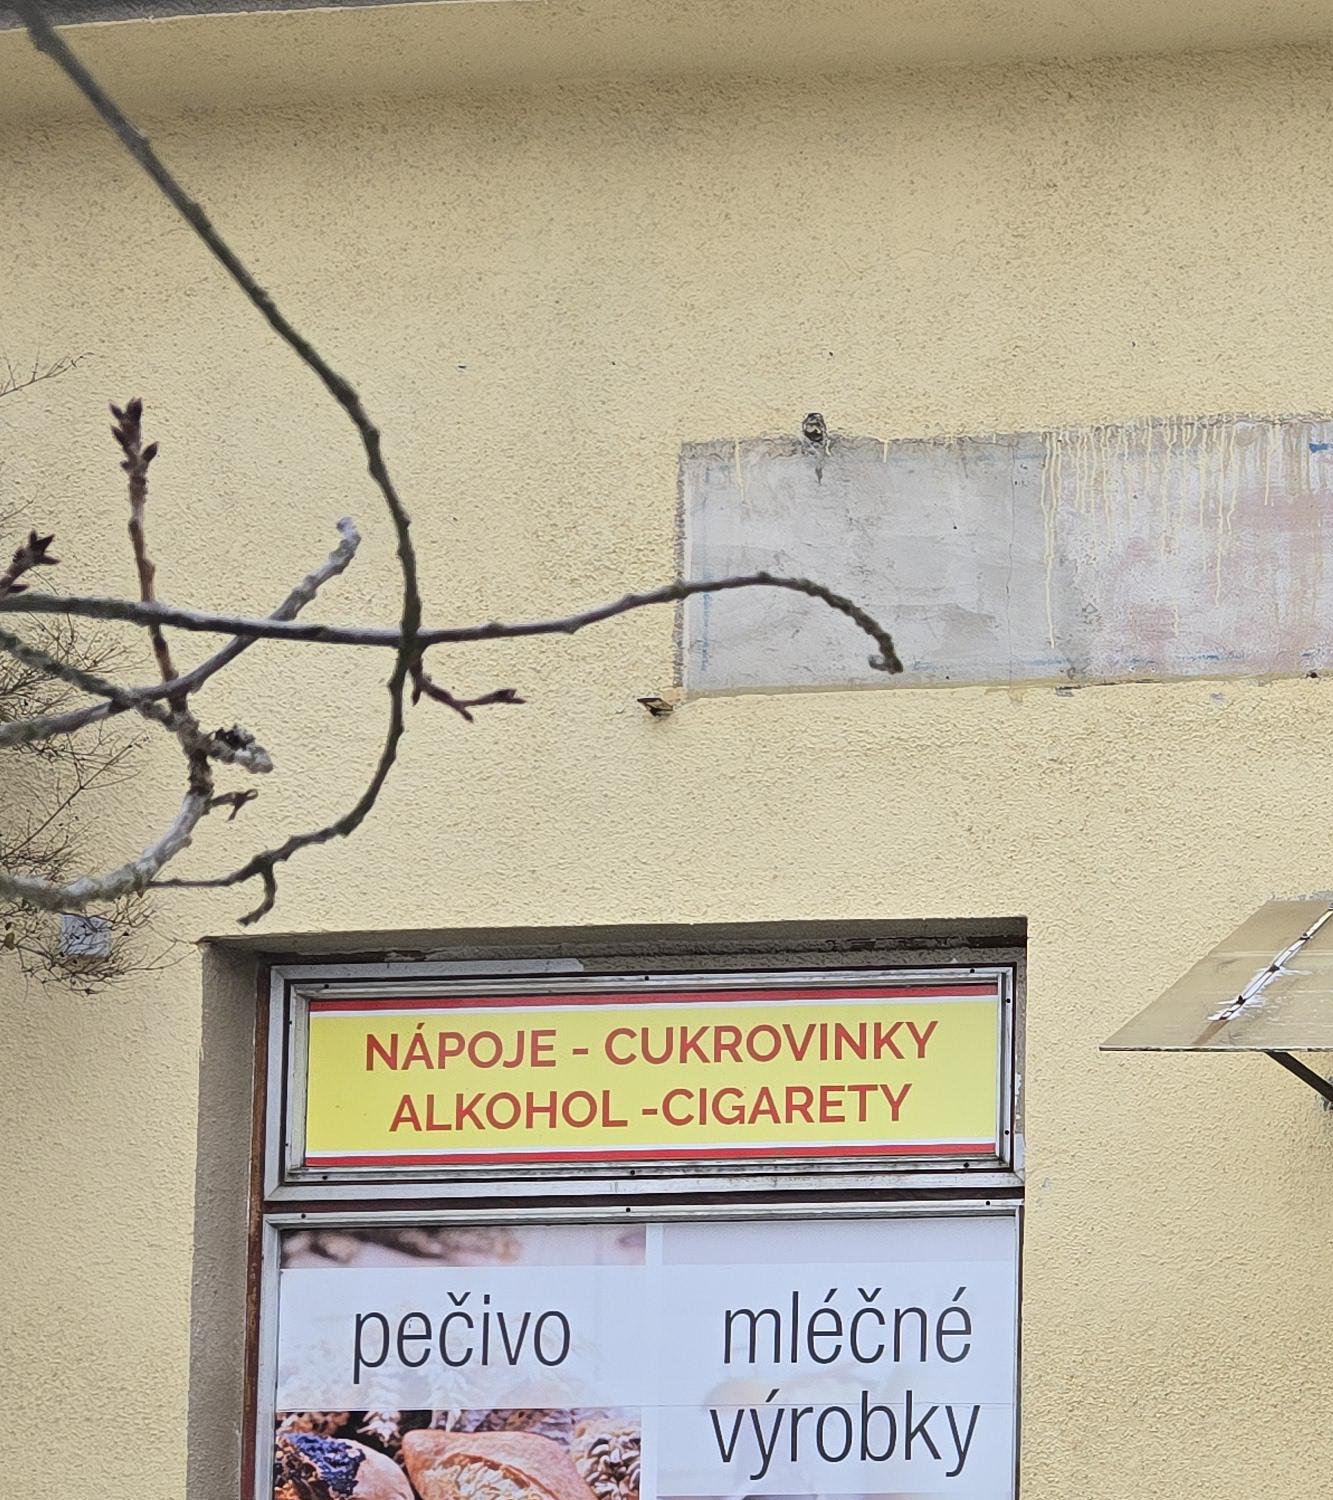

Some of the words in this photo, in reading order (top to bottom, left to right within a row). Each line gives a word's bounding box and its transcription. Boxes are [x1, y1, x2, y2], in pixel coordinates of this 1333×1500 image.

[364, 1022, 557, 1072] NÁPOJE
[603, 1020, 939, 1067] CUKROVINKY
[388, 1089, 629, 1133] ALKOHOL
[351, 1290, 572, 1386] pečivo
[722, 1286, 974, 1365] mléčné
[709, 1389, 981, 1482] výrobky
